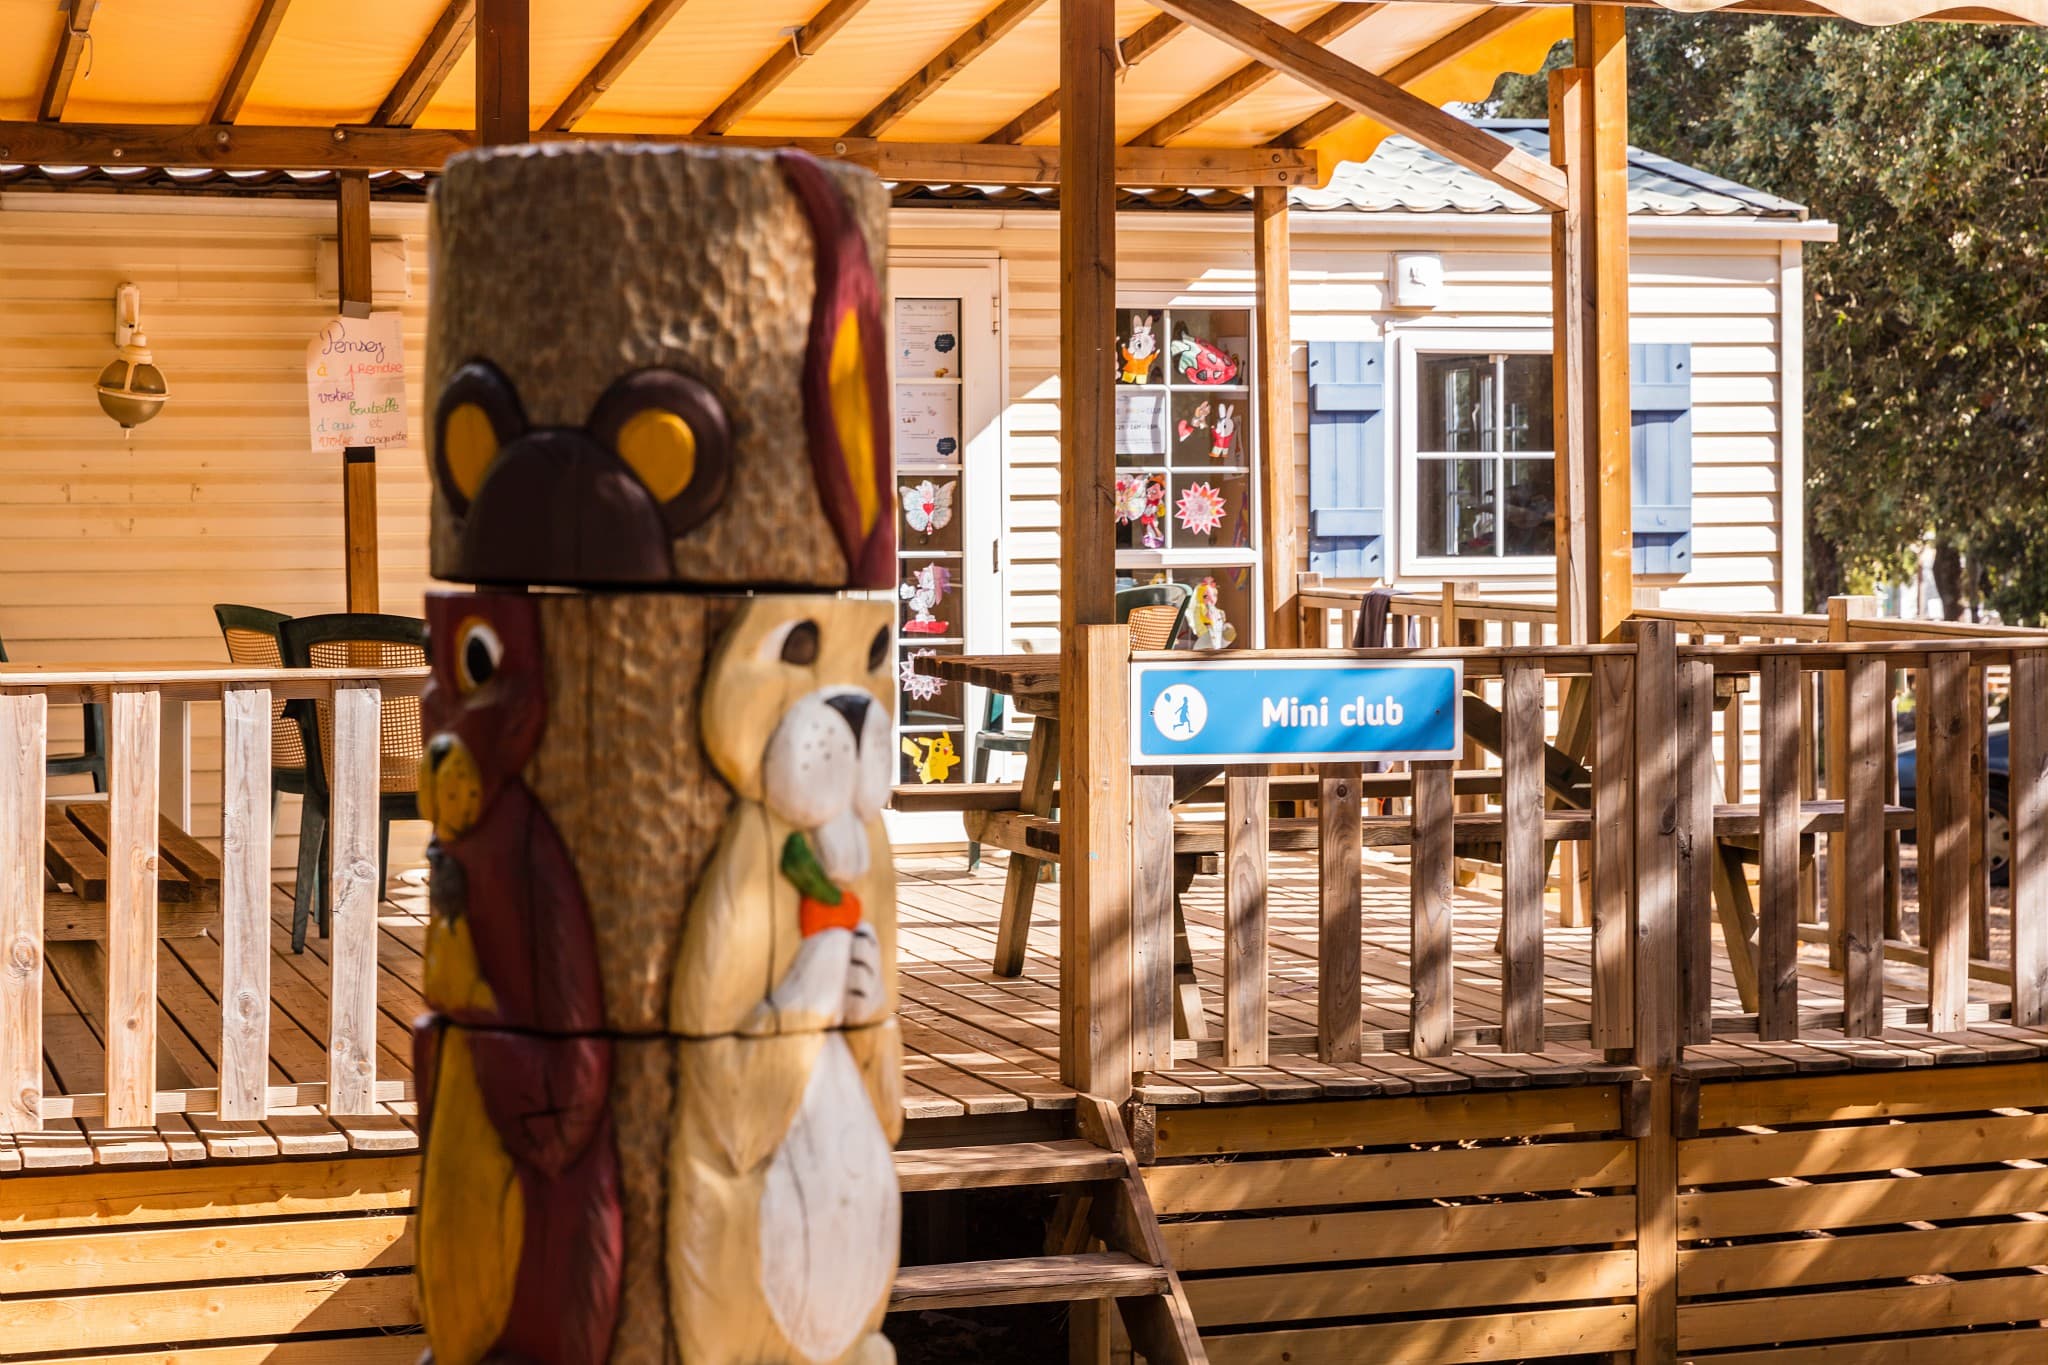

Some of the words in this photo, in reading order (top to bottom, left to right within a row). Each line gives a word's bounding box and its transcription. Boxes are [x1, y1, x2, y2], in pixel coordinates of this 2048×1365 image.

[319, 320, 386, 363] Pensez
[1262, 696, 1329, 728] Mini
[1340, 695, 1404, 726] club
